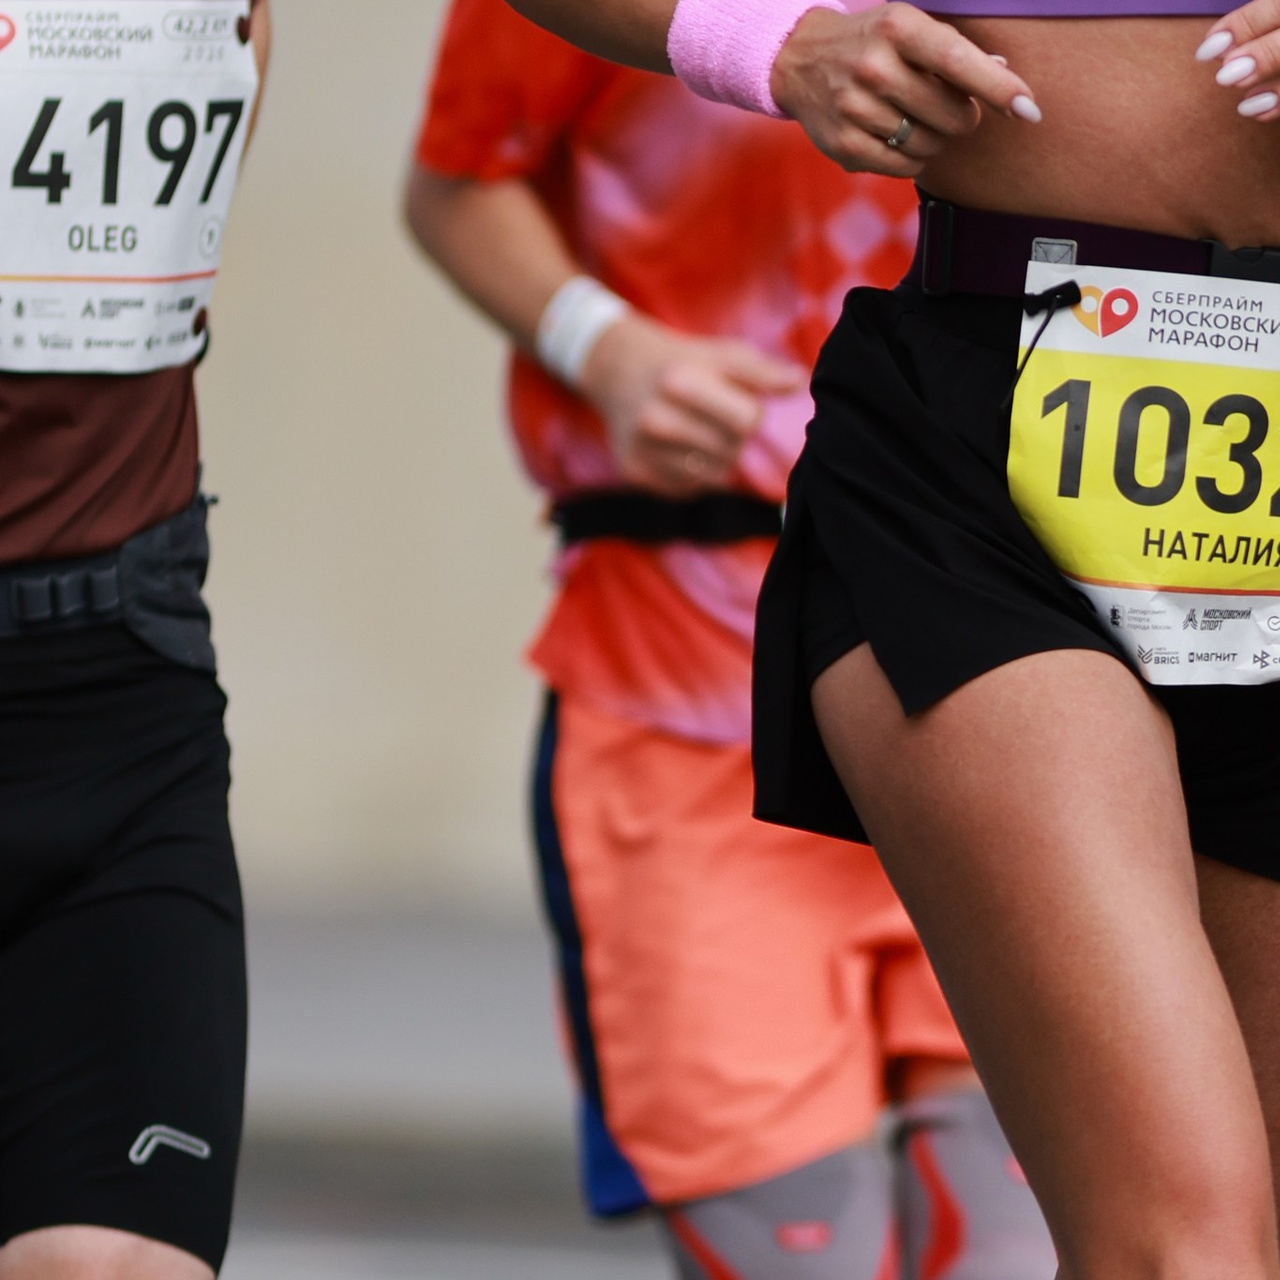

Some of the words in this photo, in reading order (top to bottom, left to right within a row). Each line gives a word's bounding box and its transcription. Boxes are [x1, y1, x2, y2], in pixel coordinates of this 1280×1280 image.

[25, 11, 119, 22] СБЕРПРАЙМ
[27, 24, 153, 42] МОСКОВСКИЙ
[29, 42, 121, 60] МАРАФОН
[12, 97, 244, 206] 4197
[68, 224, 137, 252] OLEG
[1152, 290, 1263, 313] СБЕРПРАЙМ
[1148, 327, 1259, 352] МАРАФОН
[1202, 607, 1252, 620] МОСКОВСКИЙ
[1200, 620, 1223, 631] СПОРТ
[1153, 656, 1180, 665] BRICS
